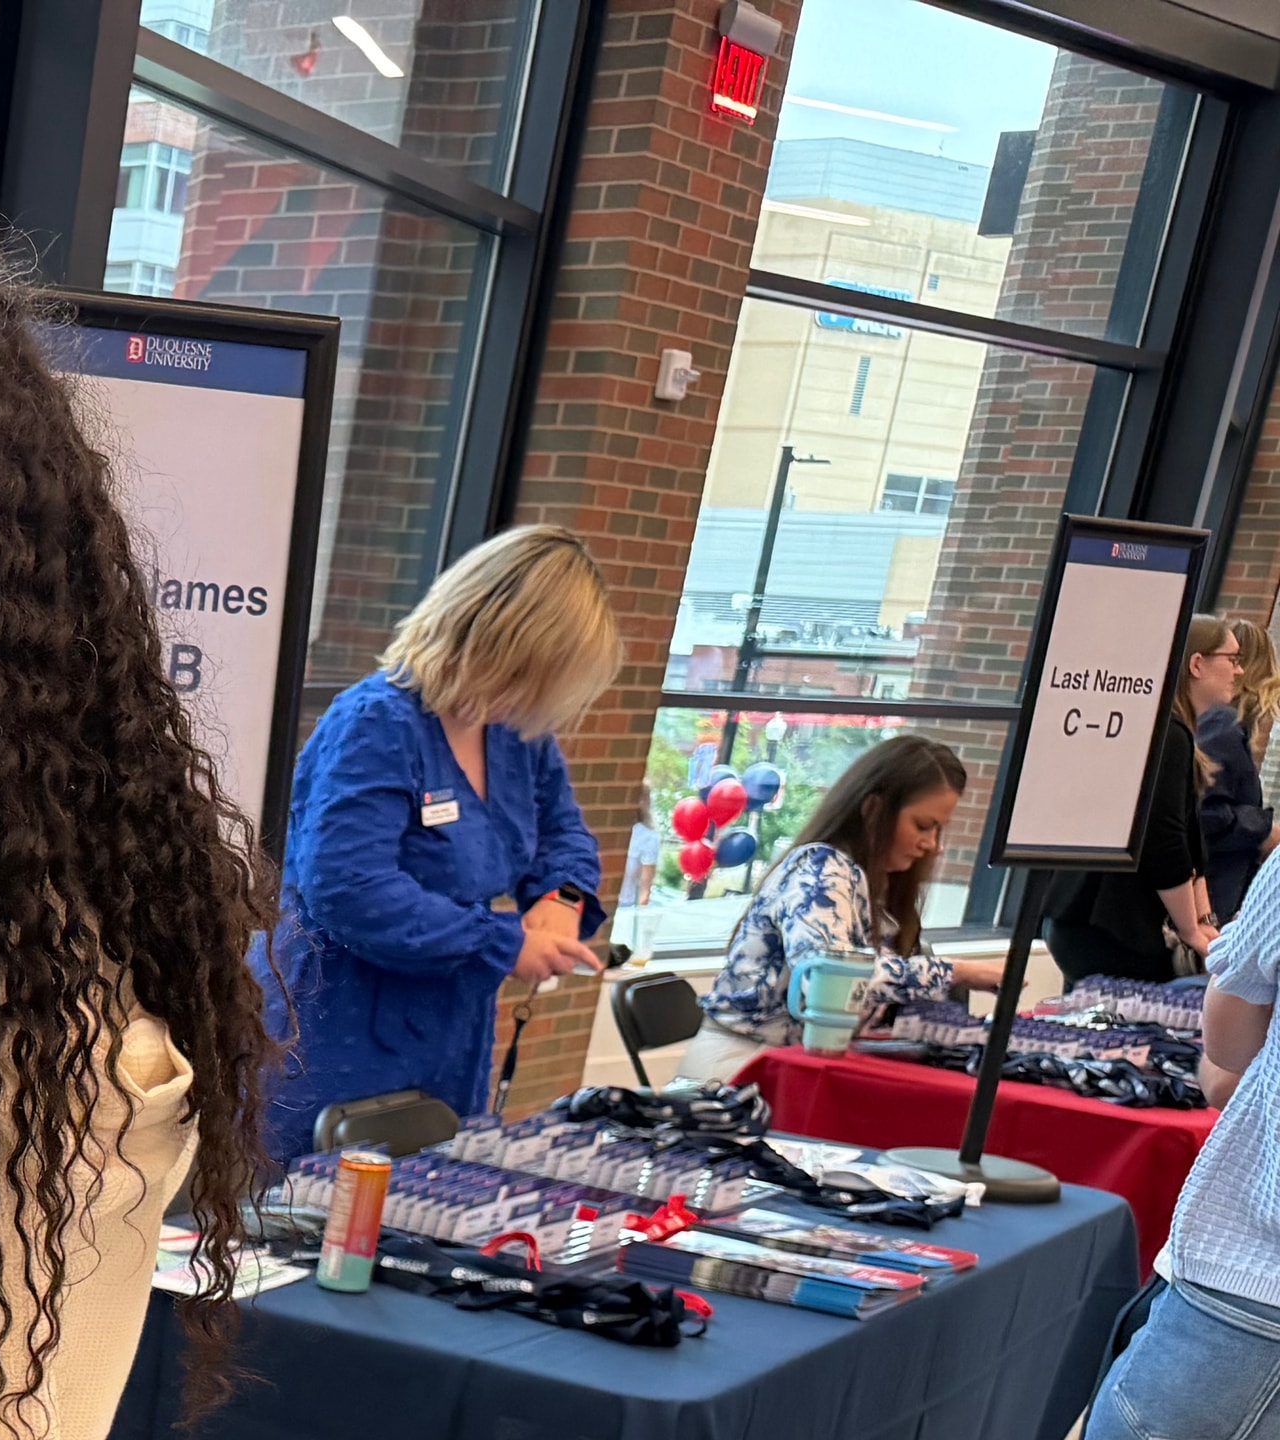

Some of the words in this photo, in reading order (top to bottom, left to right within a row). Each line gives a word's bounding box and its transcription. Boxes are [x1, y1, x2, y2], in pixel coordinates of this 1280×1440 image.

[144, 351, 212, 372] UNIVERSITY
[145, 336, 212, 358] DUQUESNE
[153, 568, 268, 617] ames
[169, 643, 203, 694] B
[1050, 666, 1088, 690] Last
[1093, 669, 1153, 696] Names
[1063, 708, 1081, 736] C
[1105, 711, 1124, 739] D
